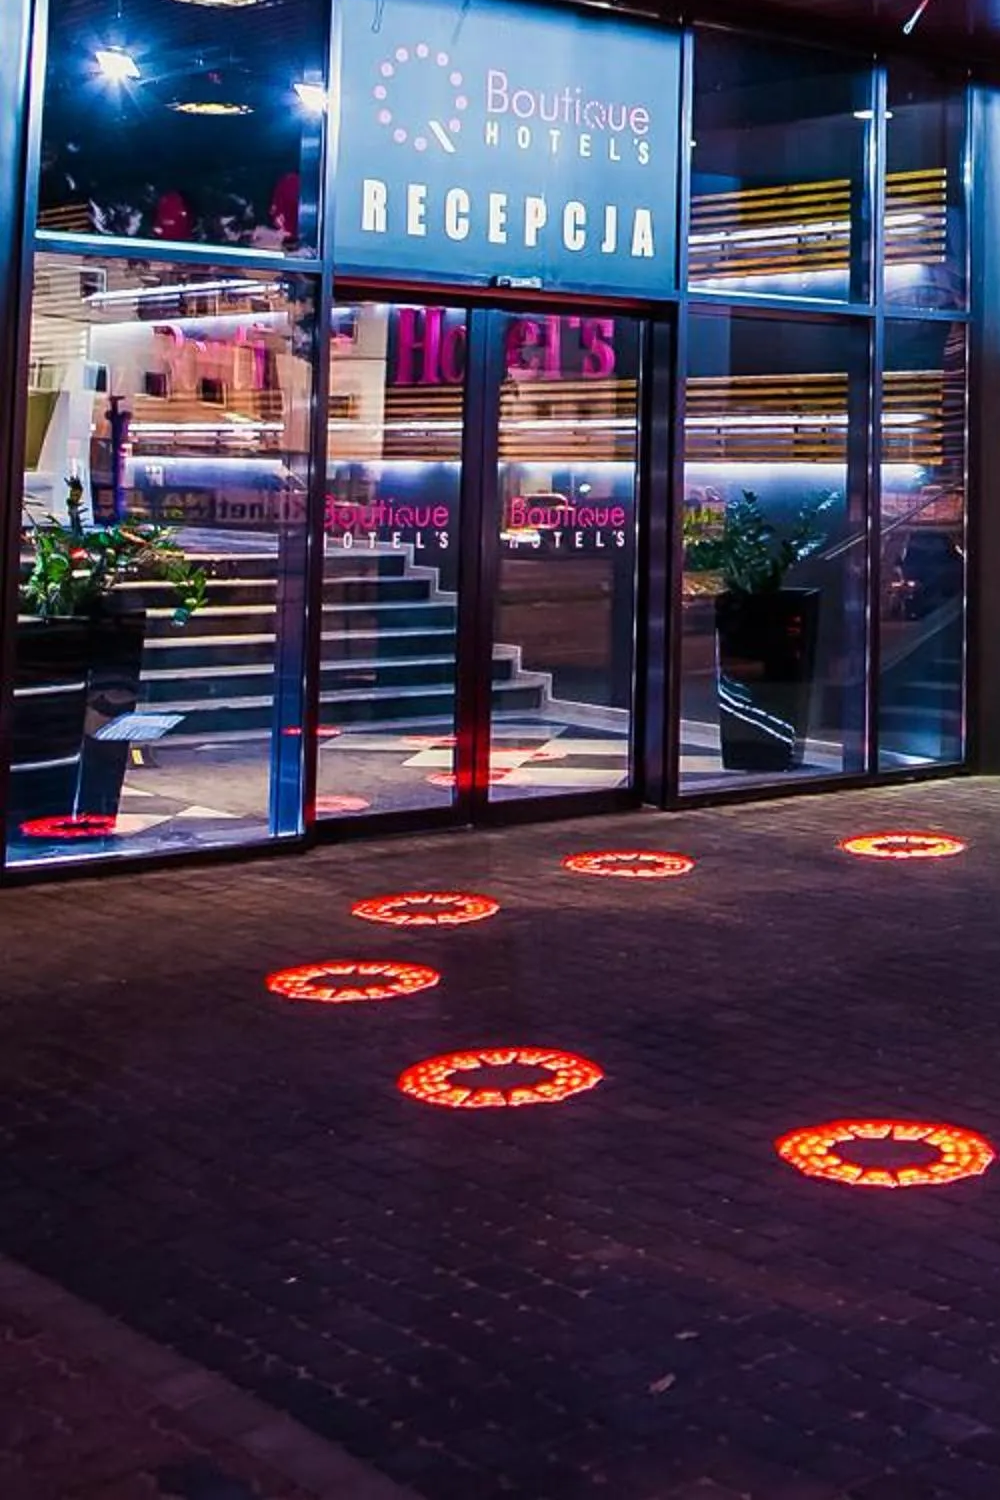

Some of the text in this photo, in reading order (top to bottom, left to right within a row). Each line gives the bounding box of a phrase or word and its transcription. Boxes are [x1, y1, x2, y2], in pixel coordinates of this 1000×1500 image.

[486, 123, 650, 165] HOTEL'S
[361, 178, 655, 258] RECEPCJA
[393, 306, 616, 384] Hoel's
